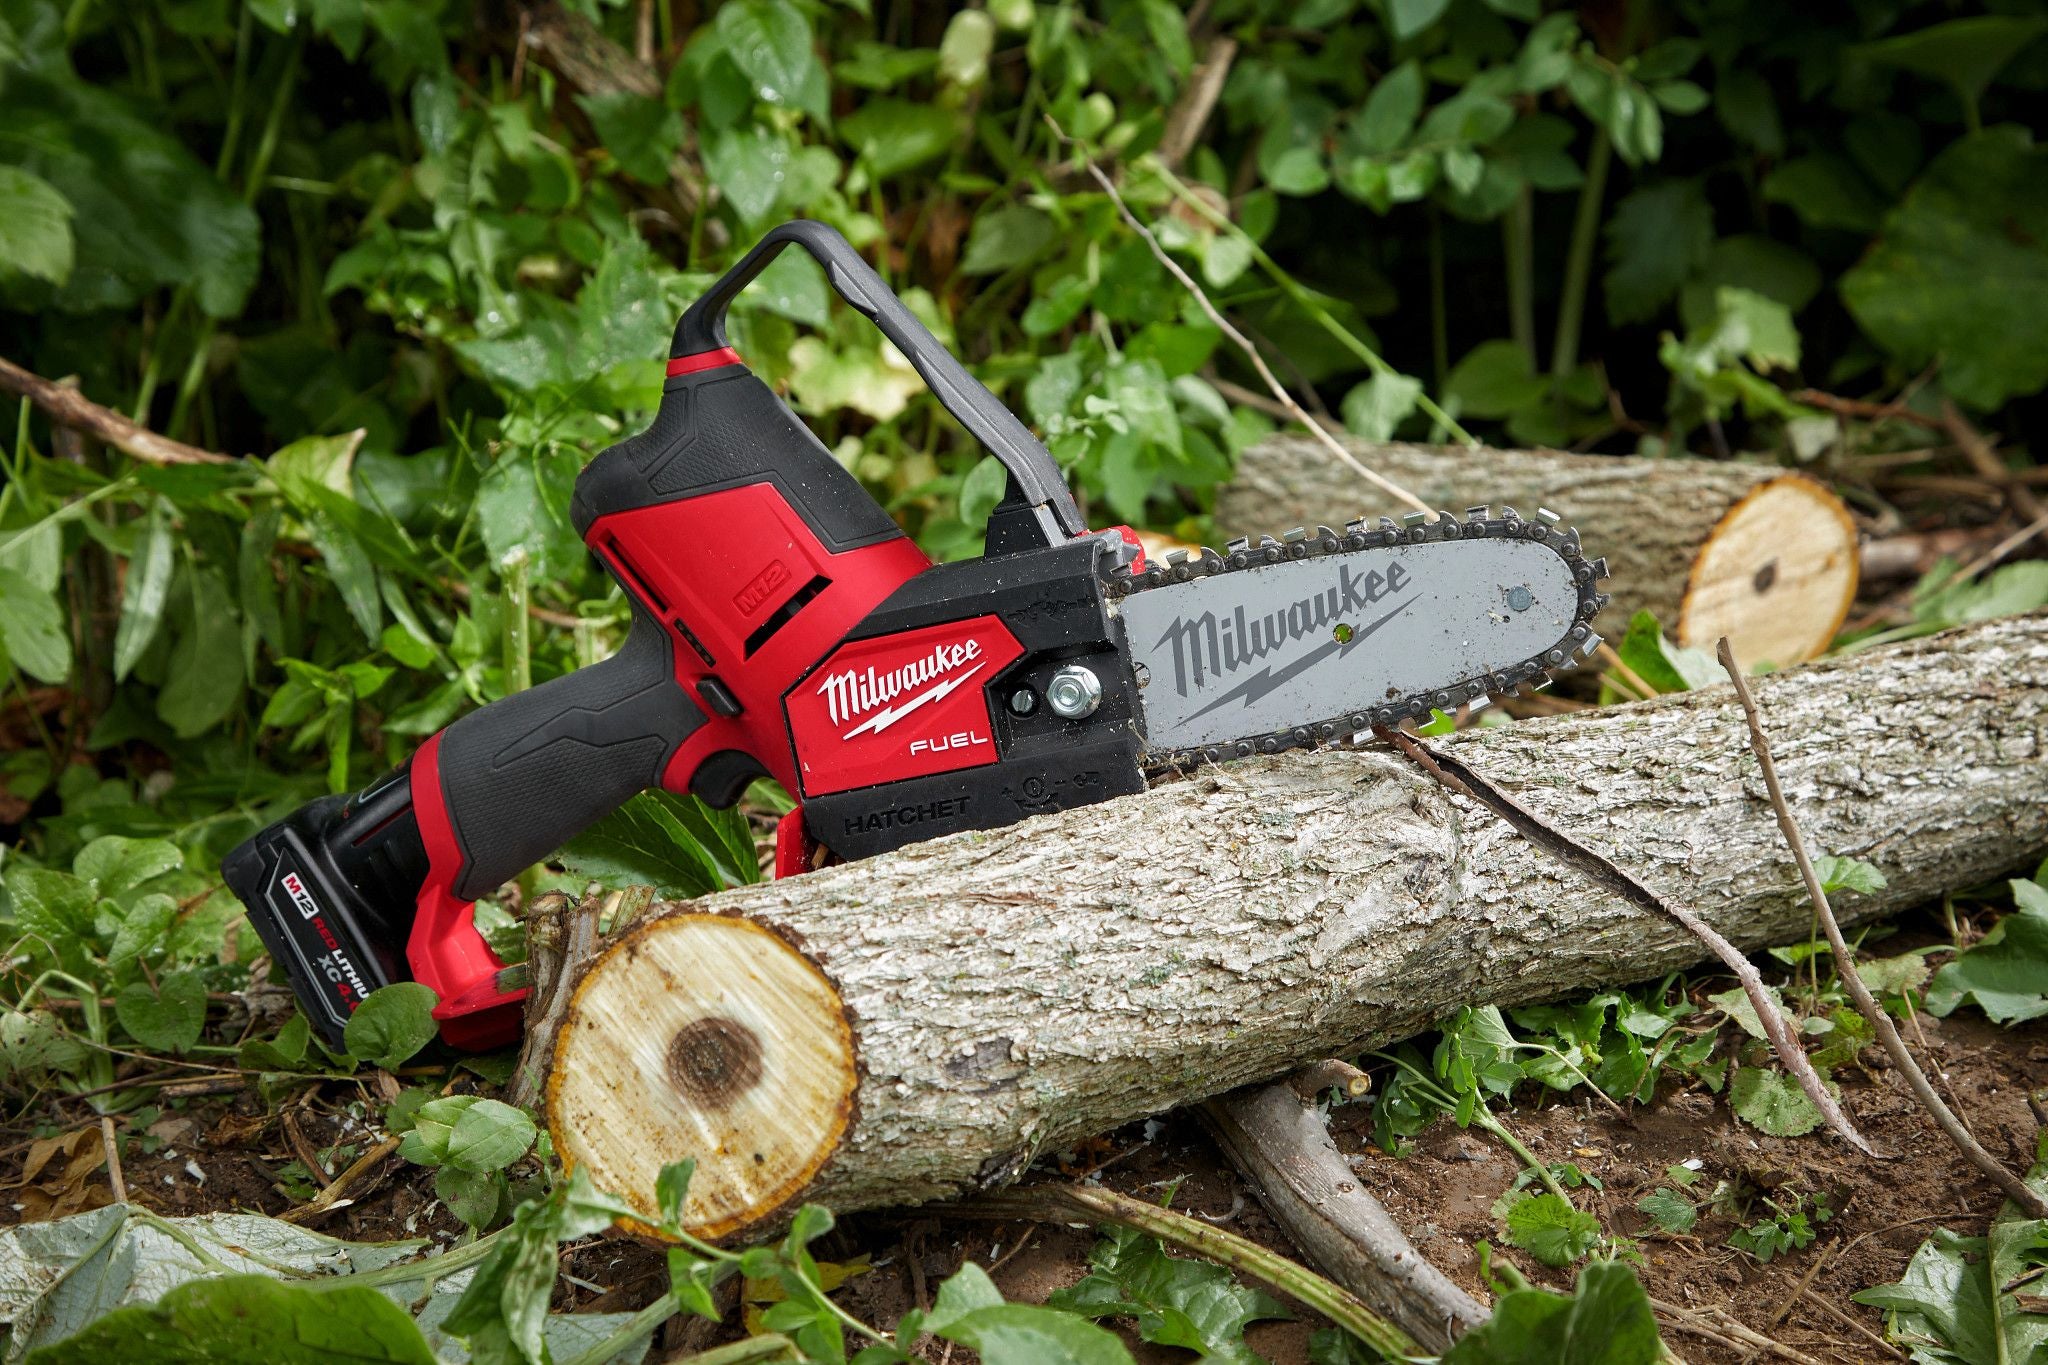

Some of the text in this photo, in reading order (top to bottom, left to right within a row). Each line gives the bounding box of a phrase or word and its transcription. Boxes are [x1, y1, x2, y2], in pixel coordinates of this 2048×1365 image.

[736, 565, 786, 613] M12
[1151, 560, 1412, 699] Milwaukee
[816, 638, 982, 727] Milwaukee
[909, 730, 988, 756] FUEL
[844, 796, 971, 836] HATCHET
[285, 875, 370, 1000] M12 REDLITHIU
[317, 954, 343, 984] XC
